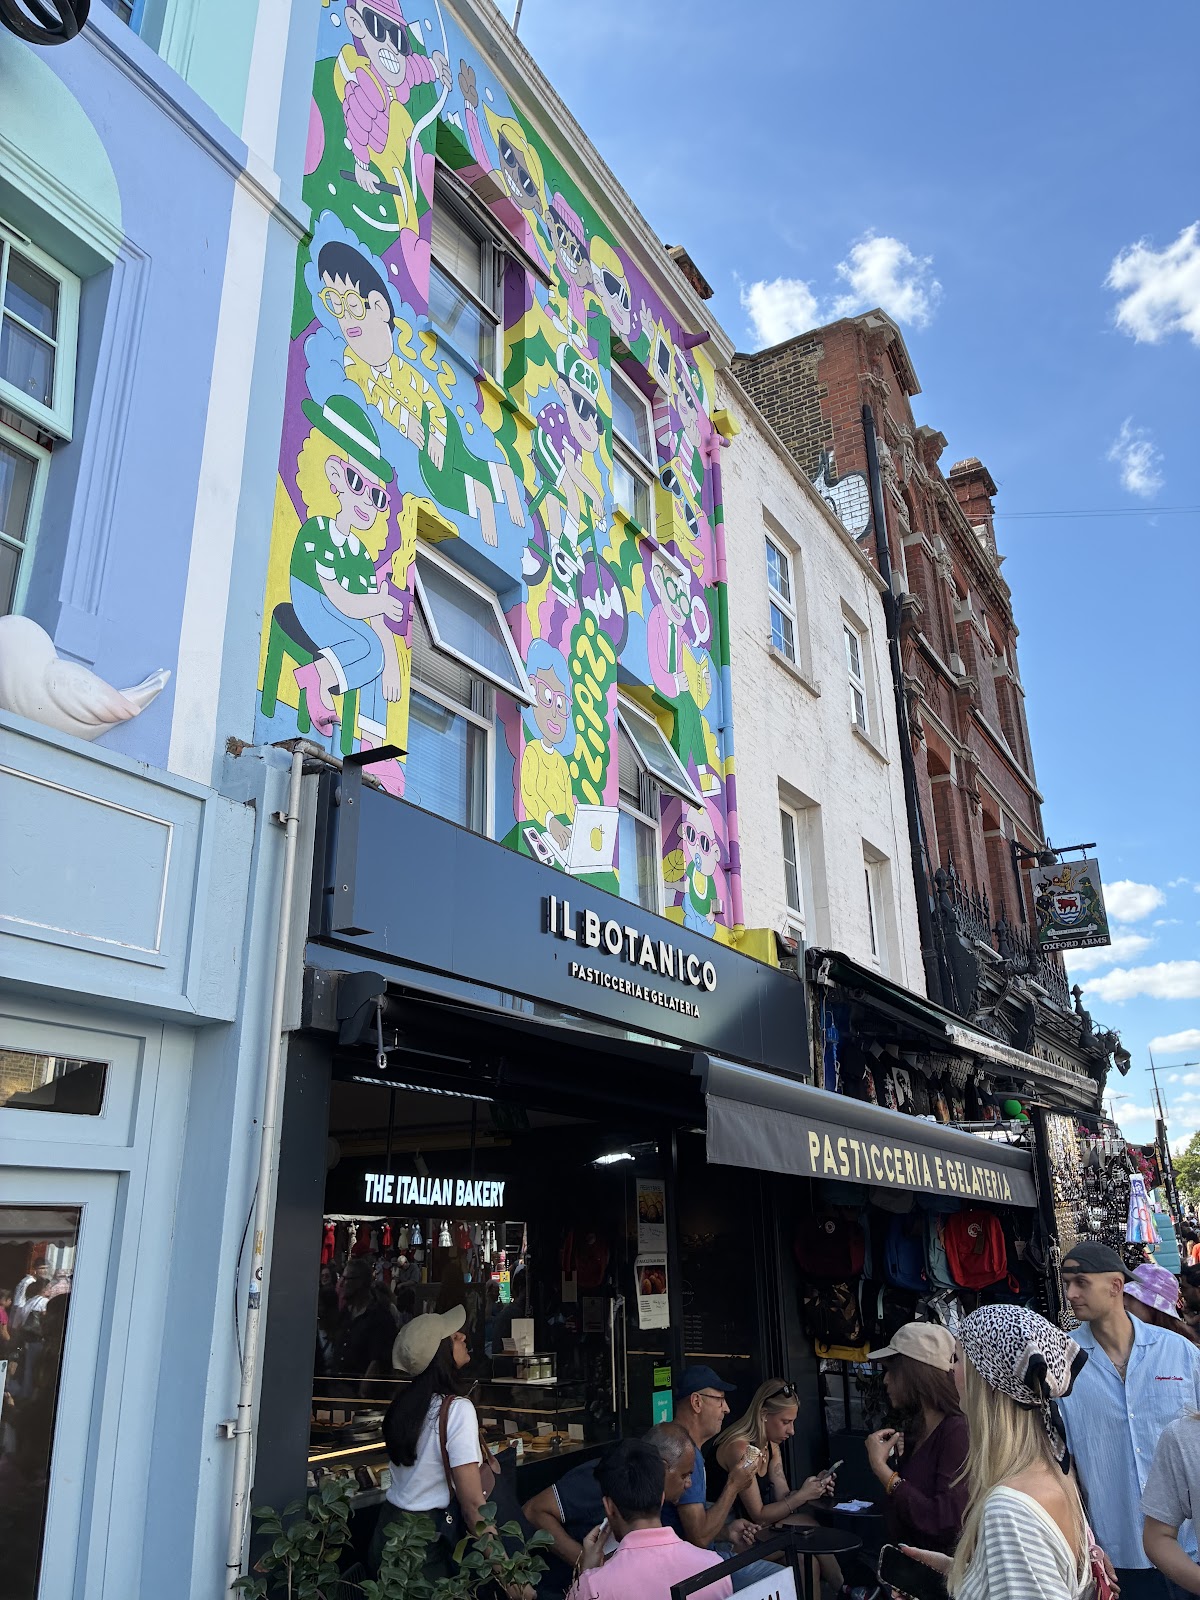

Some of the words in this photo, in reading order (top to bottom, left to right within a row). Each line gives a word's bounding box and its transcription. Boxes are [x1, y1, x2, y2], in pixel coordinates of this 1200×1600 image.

[548, 895, 577, 941] IL
[584, 909, 718, 992] BOTANICO
[1042, 939, 1079, 951] OXFORD
[1080, 936, 1107, 946] ARMS
[571, 961, 643, 998] PASTICCERIA
[643, 986, 650, 1000] E
[650, 989, 701, 1019] GELATERIA
[364, 1173, 395, 1204] THE
[395, 1175, 454, 1206] ITALIAN
[455, 1179, 506, 1208] BAKERY
[808, 1131, 933, 1188] PASTICCERIA
[934, 1156, 947, 1190] E
[946, 1159, 1013, 1202] GELATERIA
